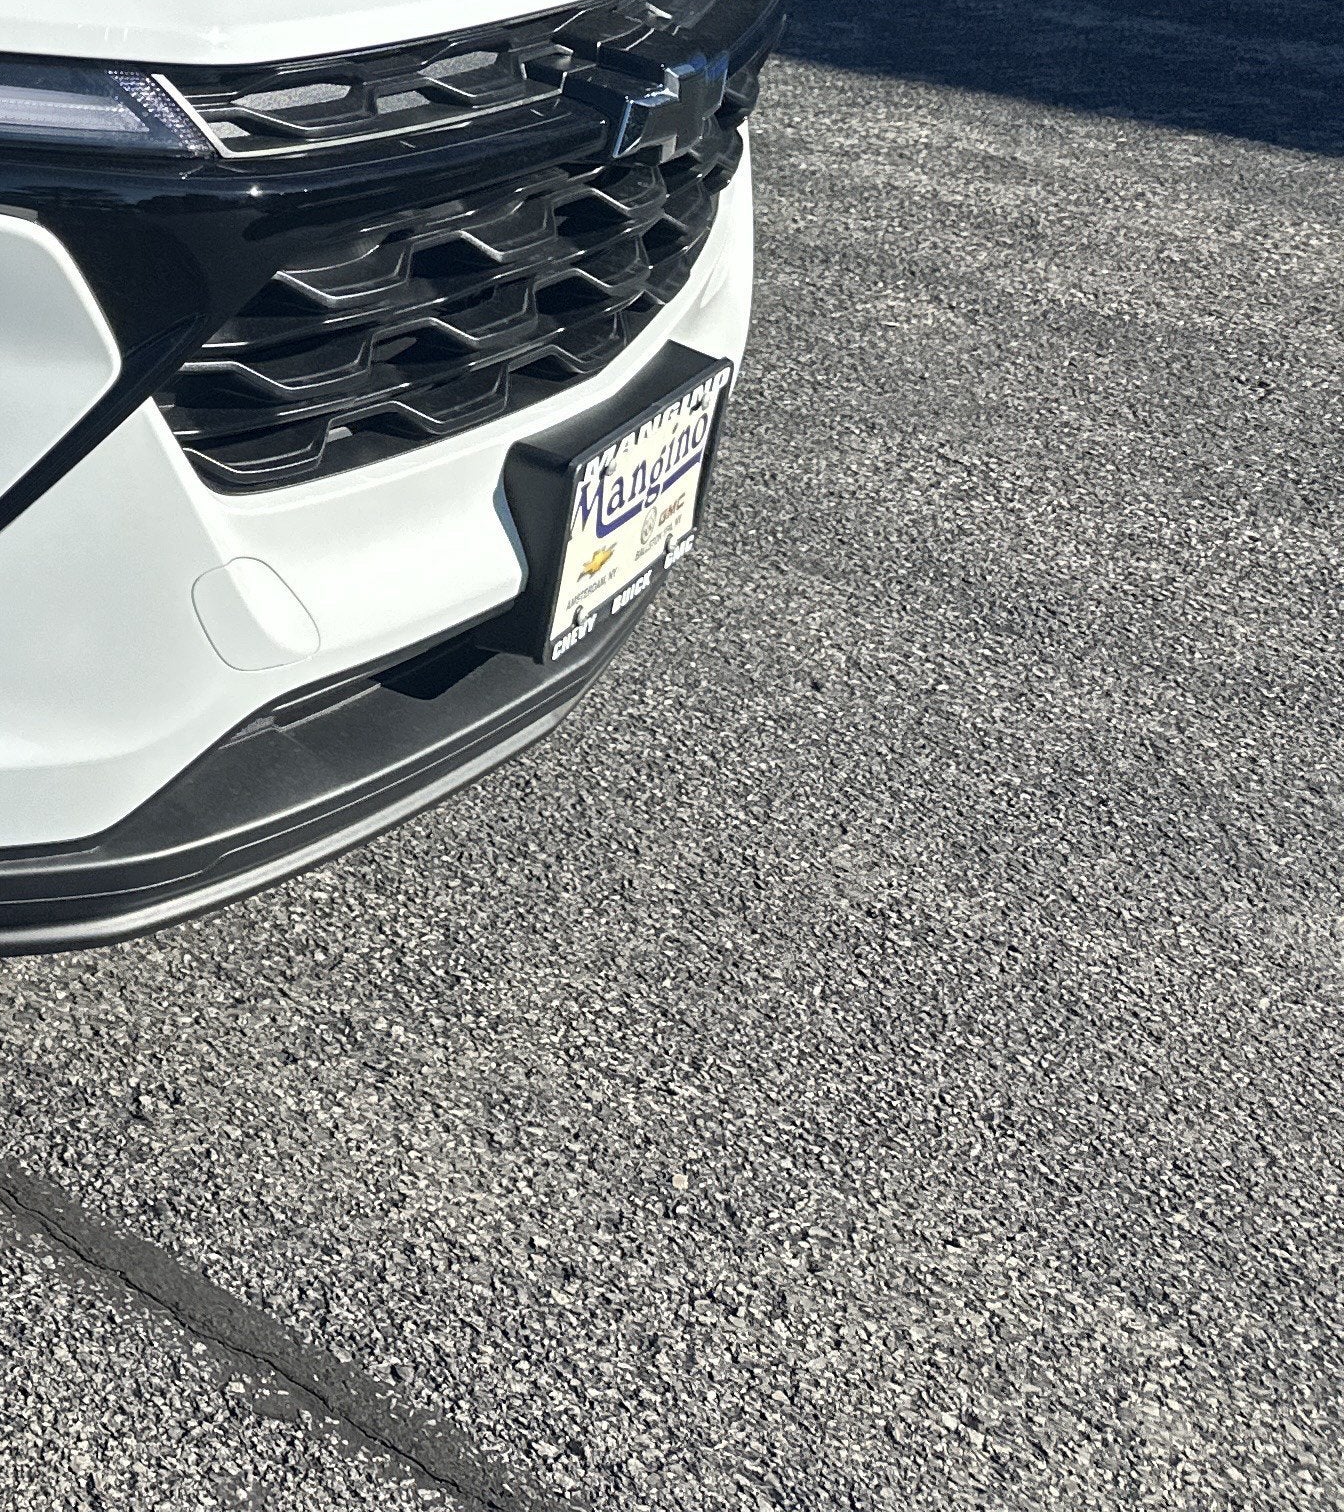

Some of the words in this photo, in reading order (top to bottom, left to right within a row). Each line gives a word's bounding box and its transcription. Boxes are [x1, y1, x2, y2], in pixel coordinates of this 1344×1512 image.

[571, 412, 709, 538] Mangino
[658, 492, 686, 526] GMC
[552, 613, 597, 661] CHEVY
[612, 569, 652, 615] BUICK
